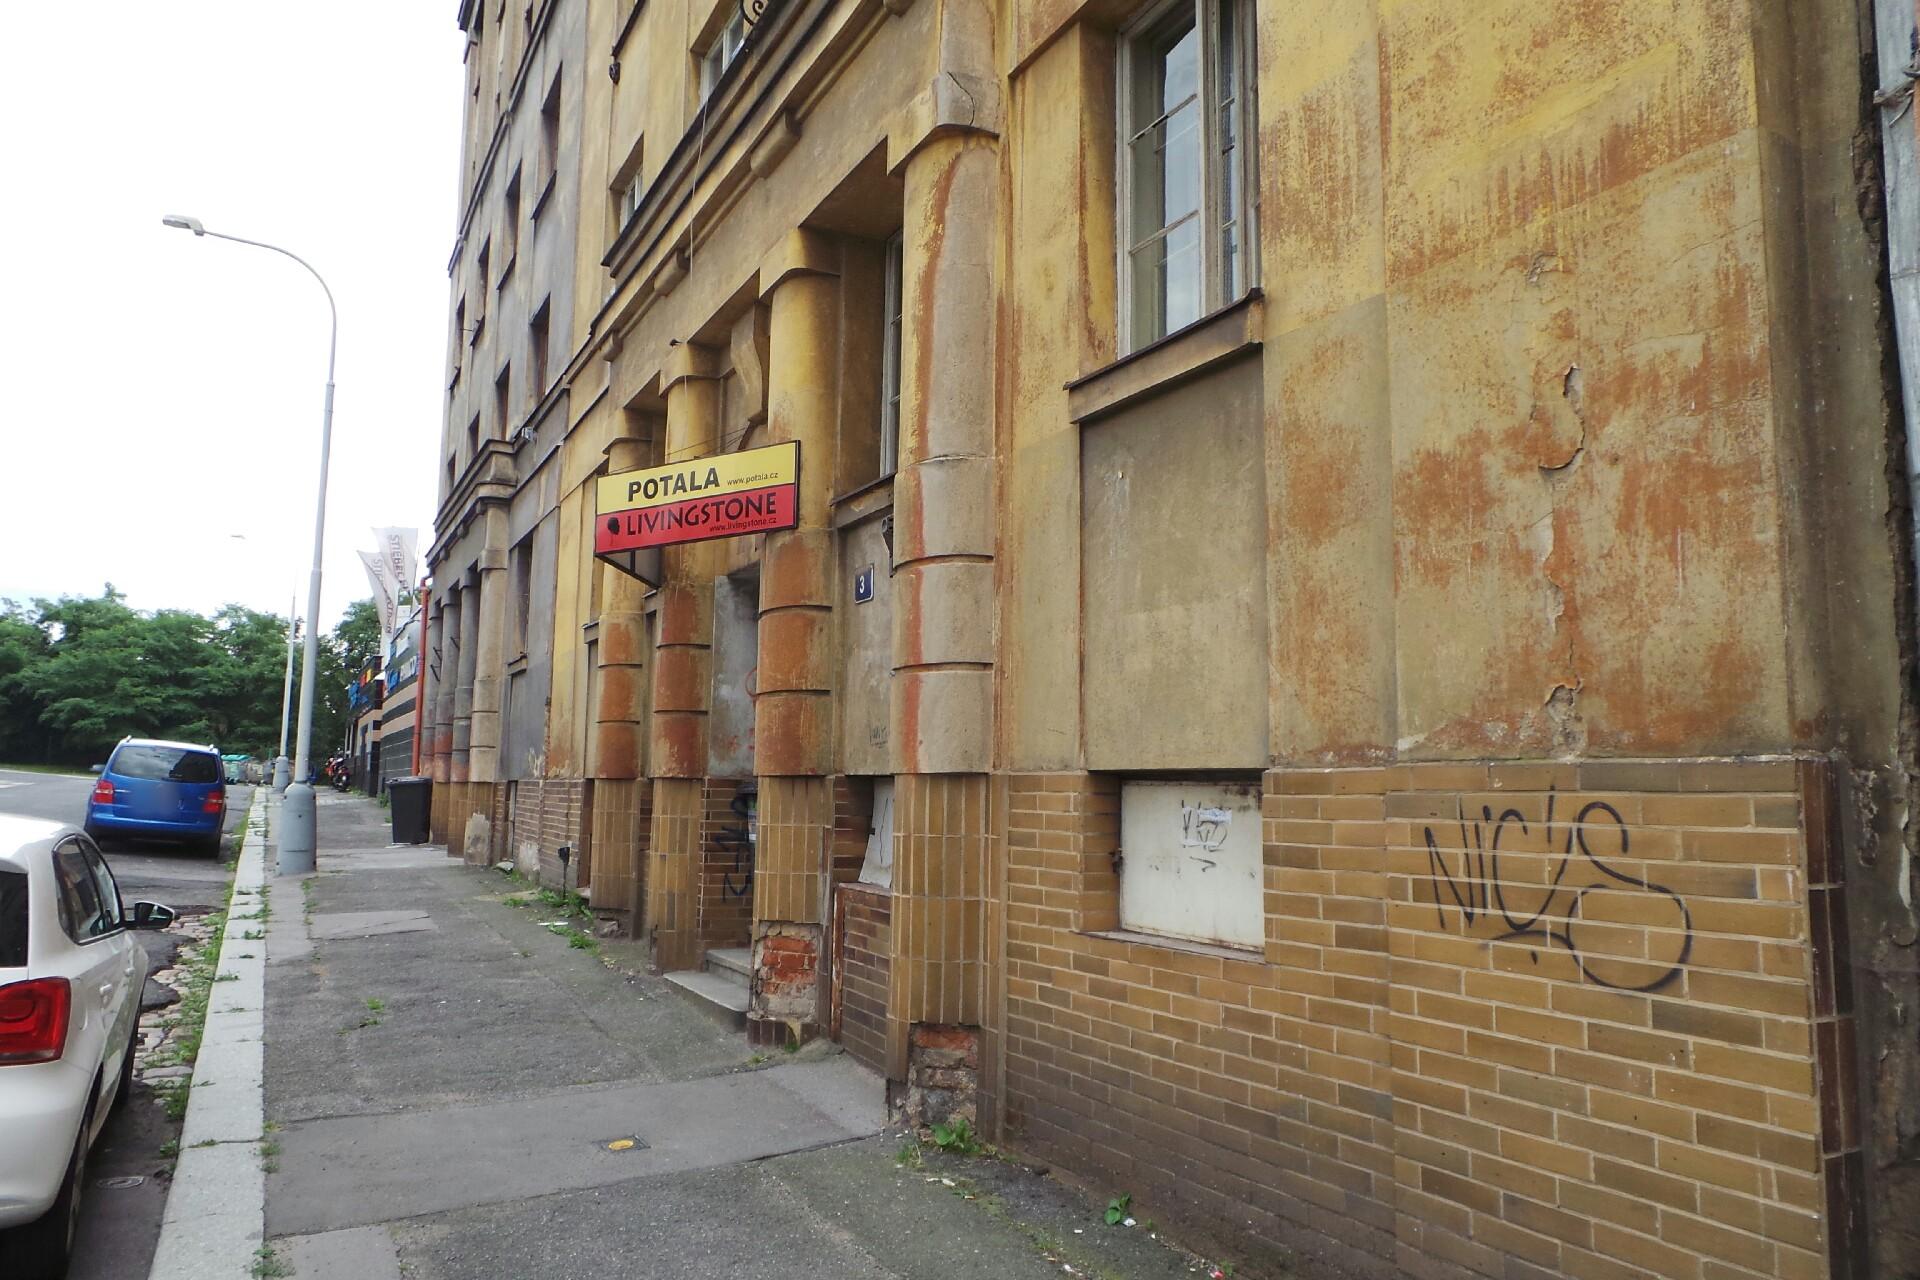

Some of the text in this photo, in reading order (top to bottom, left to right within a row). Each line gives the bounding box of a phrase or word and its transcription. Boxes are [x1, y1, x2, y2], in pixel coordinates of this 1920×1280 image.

[628, 467, 720, 502] POTALA
[726, 472, 779, 486] www.potala.cz
[627, 492, 777, 536] LIVINGSTONE
[709, 517, 777, 533] www.livingstone.cz
[859, 575, 865, 594] 3
